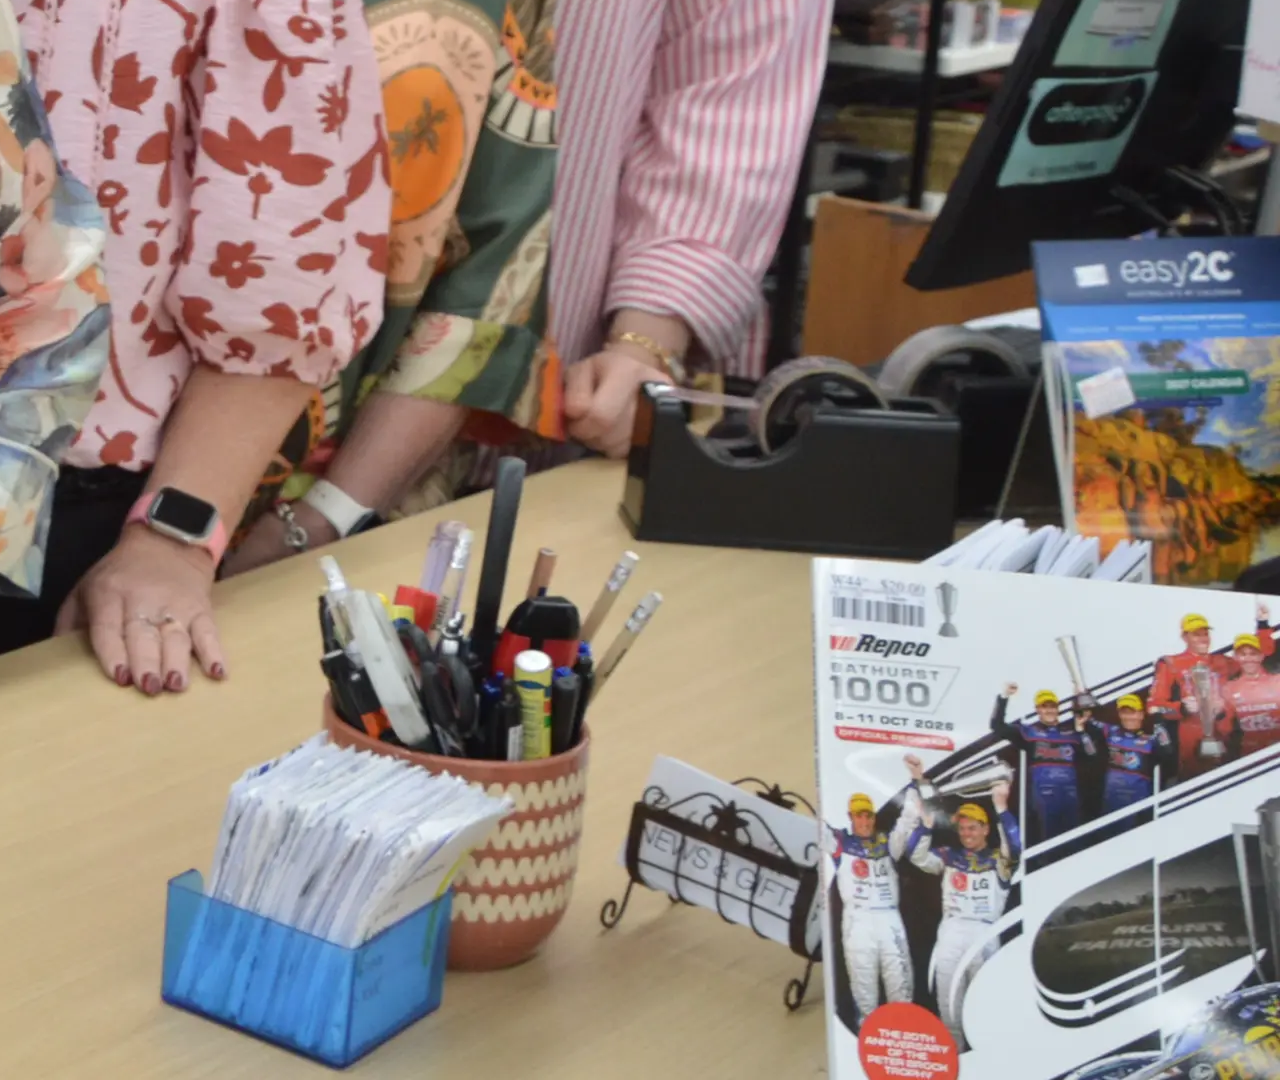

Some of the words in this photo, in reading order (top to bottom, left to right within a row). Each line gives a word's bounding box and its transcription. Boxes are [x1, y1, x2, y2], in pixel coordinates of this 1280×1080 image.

[1119, 249, 1235, 288] easy2C
[855, 633, 931, 658] Repco
[831, 662, 940, 681] BATHURST
[829, 675, 932, 708] 1000
[879, 715, 909, 727] OCT
[735, 867, 796, 908] GFT
[972, 878, 989, 891] LG
